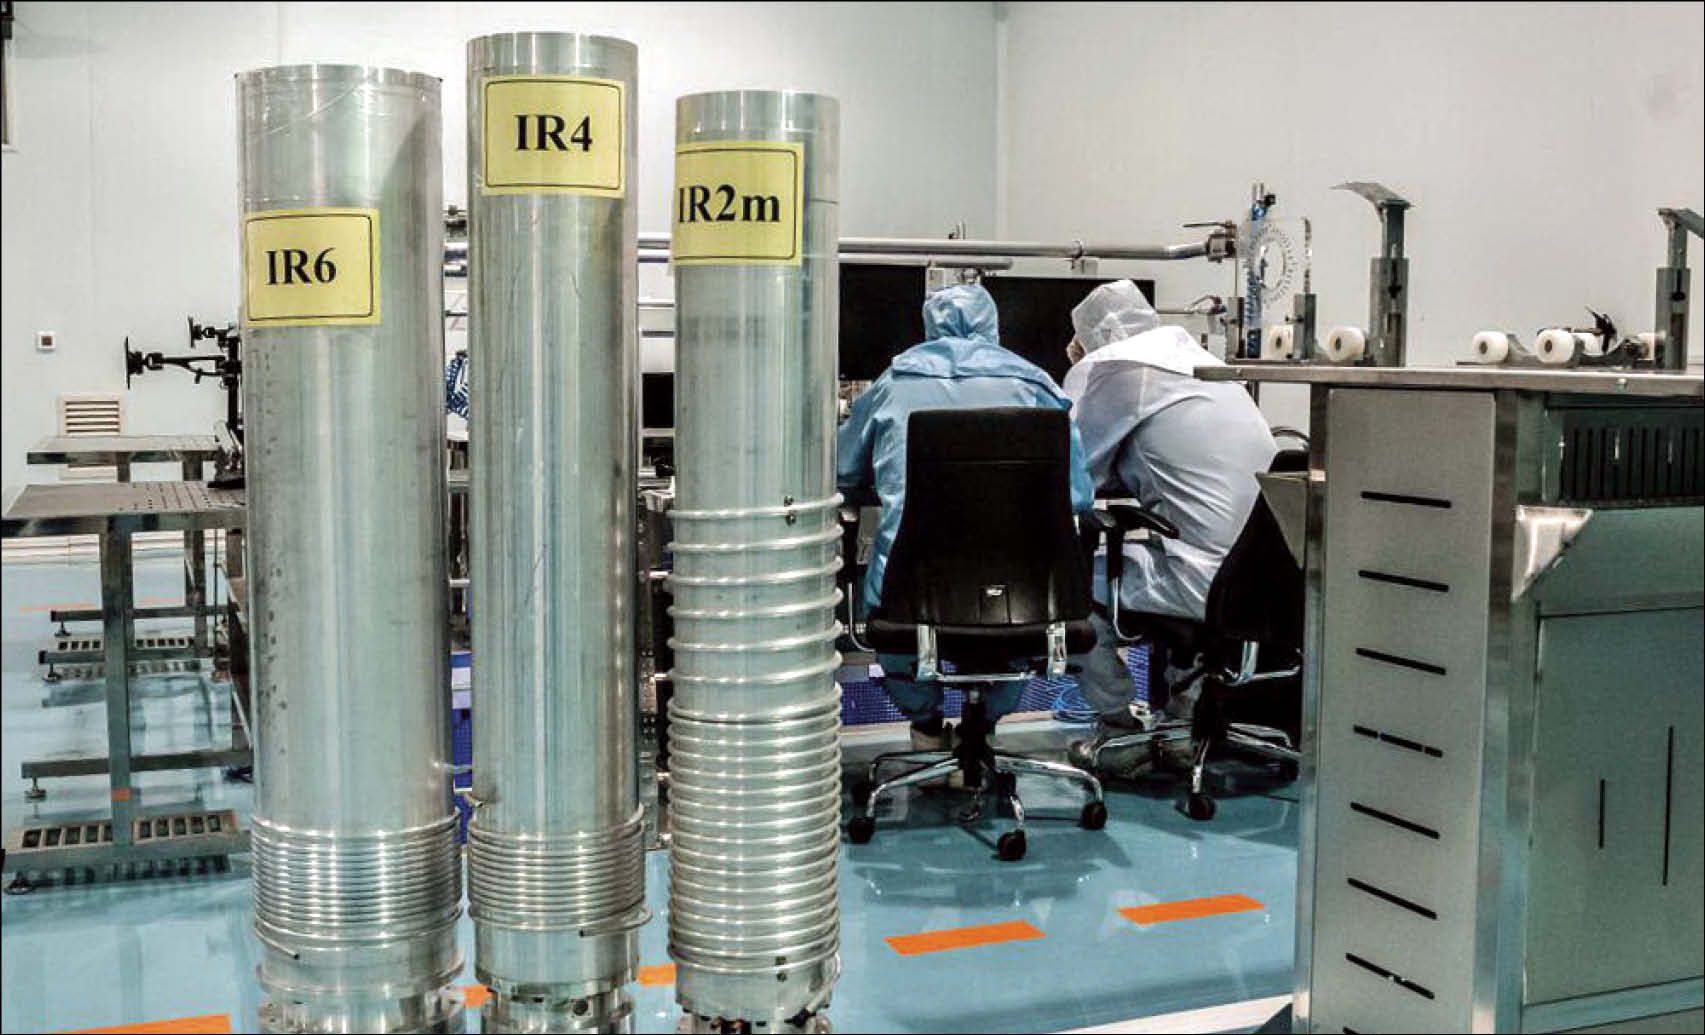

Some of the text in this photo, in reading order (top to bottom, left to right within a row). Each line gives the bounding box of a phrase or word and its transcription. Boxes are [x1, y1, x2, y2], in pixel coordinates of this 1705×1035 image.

[515, 114, 594, 152] IR4
[678, 184, 781, 223] IR2m
[266, 248, 337, 286] IR6
